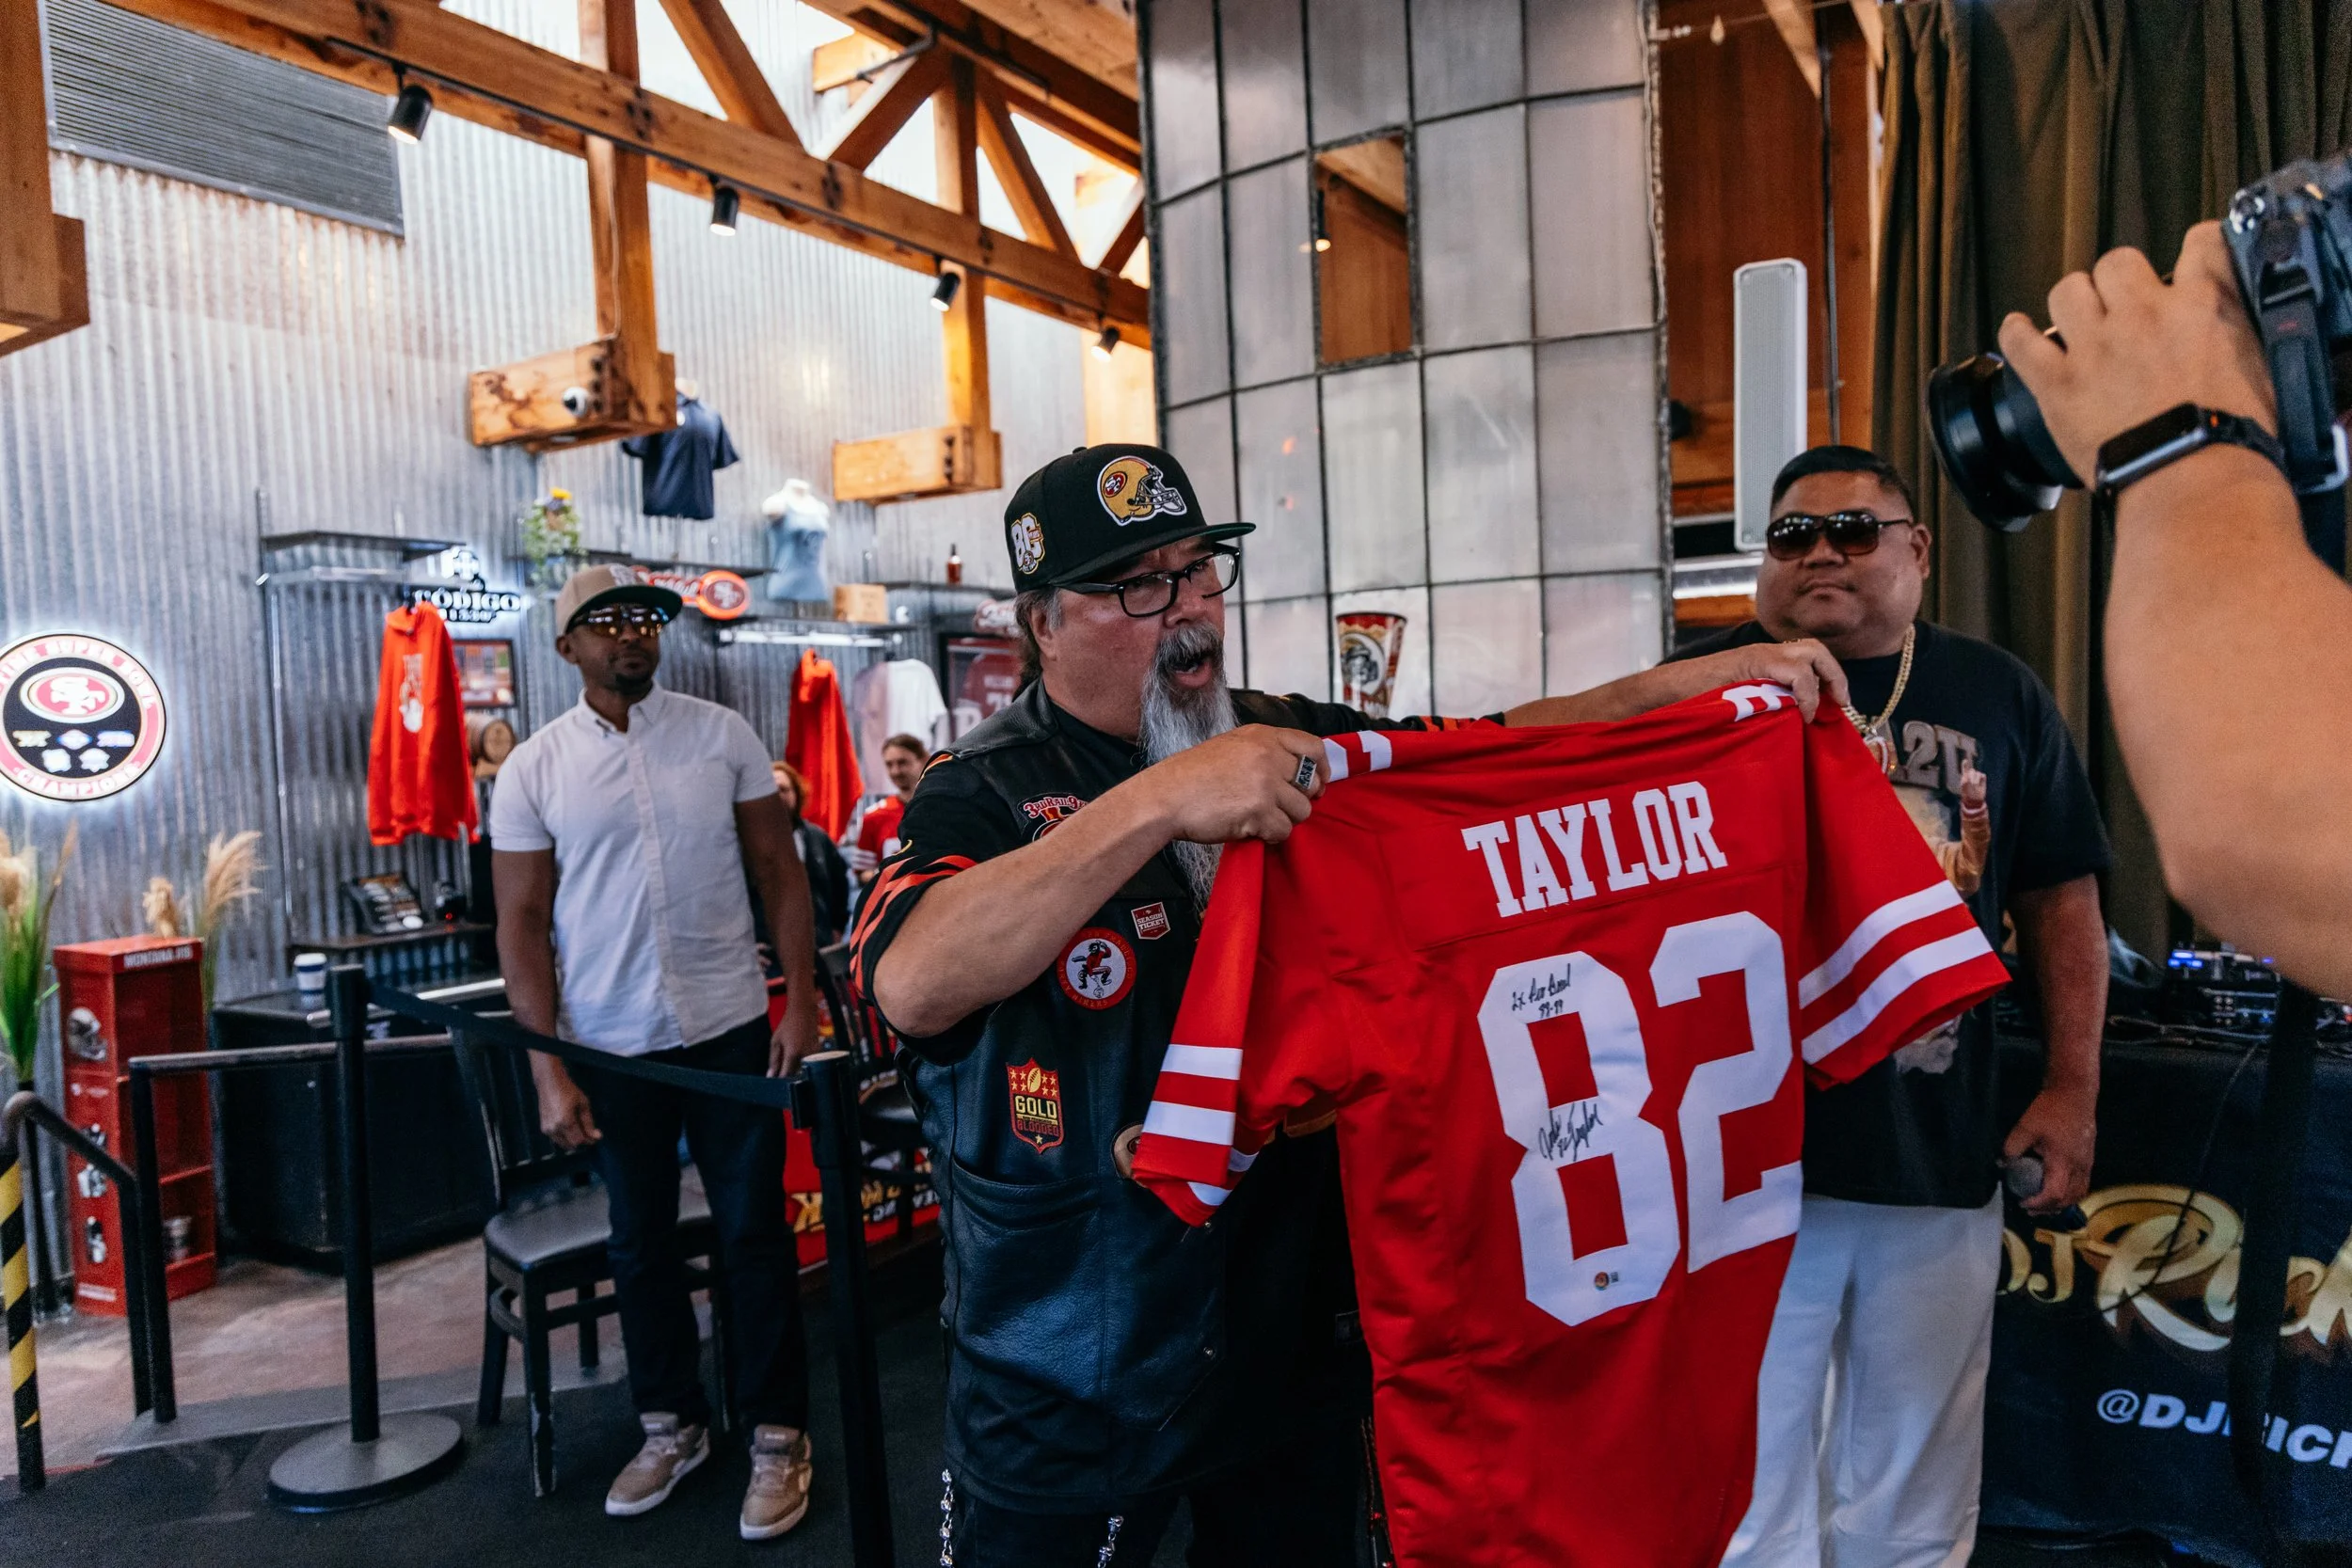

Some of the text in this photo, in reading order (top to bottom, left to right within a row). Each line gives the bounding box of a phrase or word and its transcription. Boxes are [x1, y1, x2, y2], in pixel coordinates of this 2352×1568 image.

[45, 639, 117, 662] SUPER
[119, 660, 156, 709] BOWL
[17, 763, 140, 798] CHAMPIONS
[1461, 780, 1728, 919] TAYLOR
[1136, 911, 1163, 925] SEASON
[1138, 917, 1165, 930] TICKET
[1015, 1094, 1058, 1119] GOLD
[1476, 911, 1803, 1327] 82
[1017, 1118, 1059, 1137] BLOODED
[2097, 1387, 2352, 1470] @DJIC
